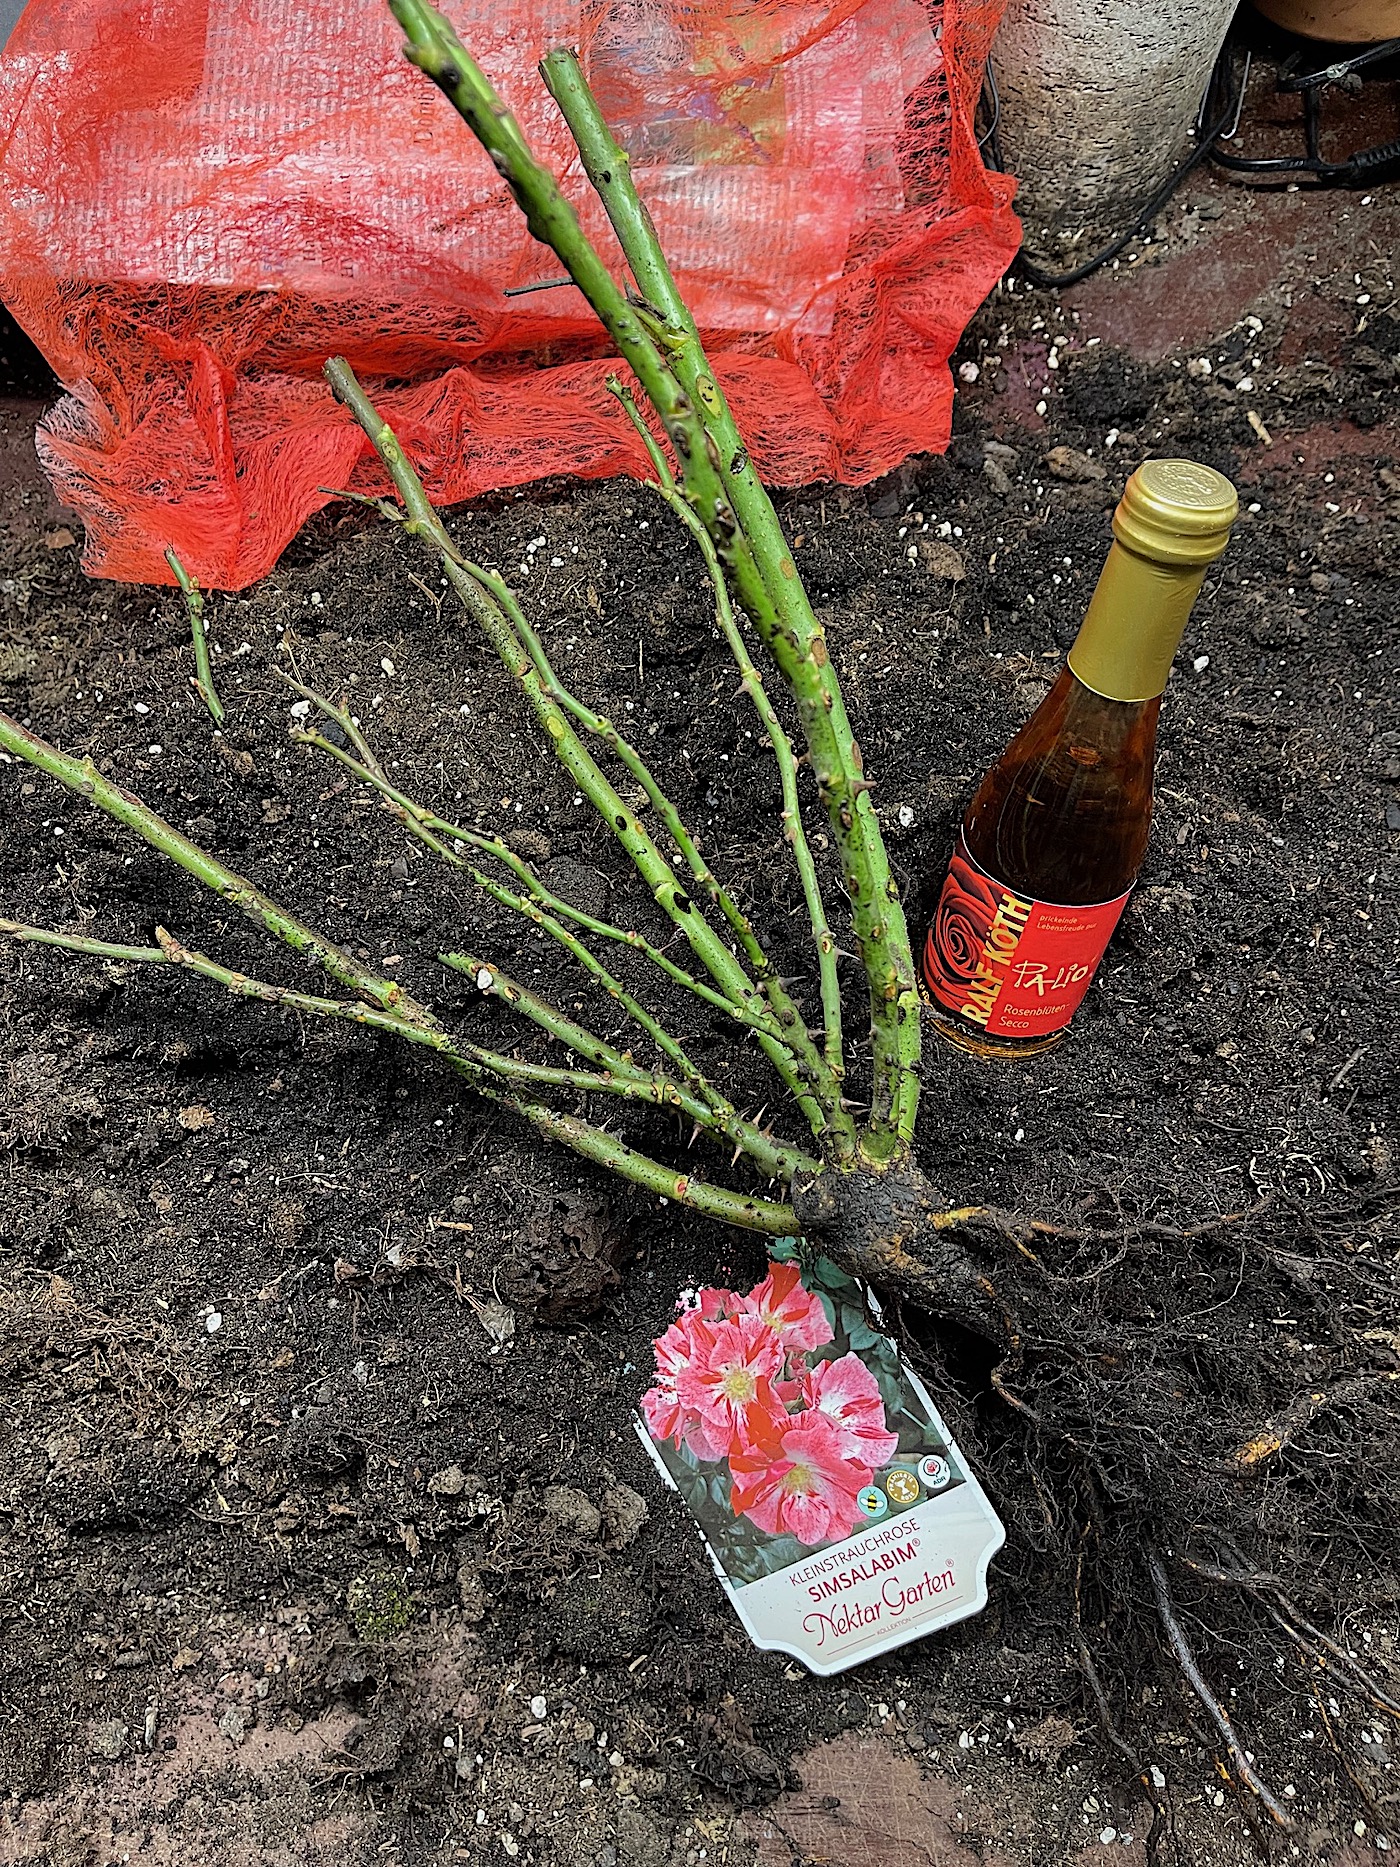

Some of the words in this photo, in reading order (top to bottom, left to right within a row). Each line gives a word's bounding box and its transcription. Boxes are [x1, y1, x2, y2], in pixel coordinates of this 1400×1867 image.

[1037, 922, 1085, 932] Lebensfreude
[1085, 923, 1098, 931] pur
[1039, 915, 1078, 924] prickelnde
[960, 962, 1003, 1024] RALF
[982, 893, 1032, 966] KÖTH
[1003, 1003, 1071, 1016] Rosenblüten-
[999, 1016, 1029, 1029] Secco
[788, 1517, 921, 1587] KLEINSTRAUCHROSE
[802, 1602, 882, 1646] Nektar
[876, 1616, 912, 1635] KOLLEKTION
